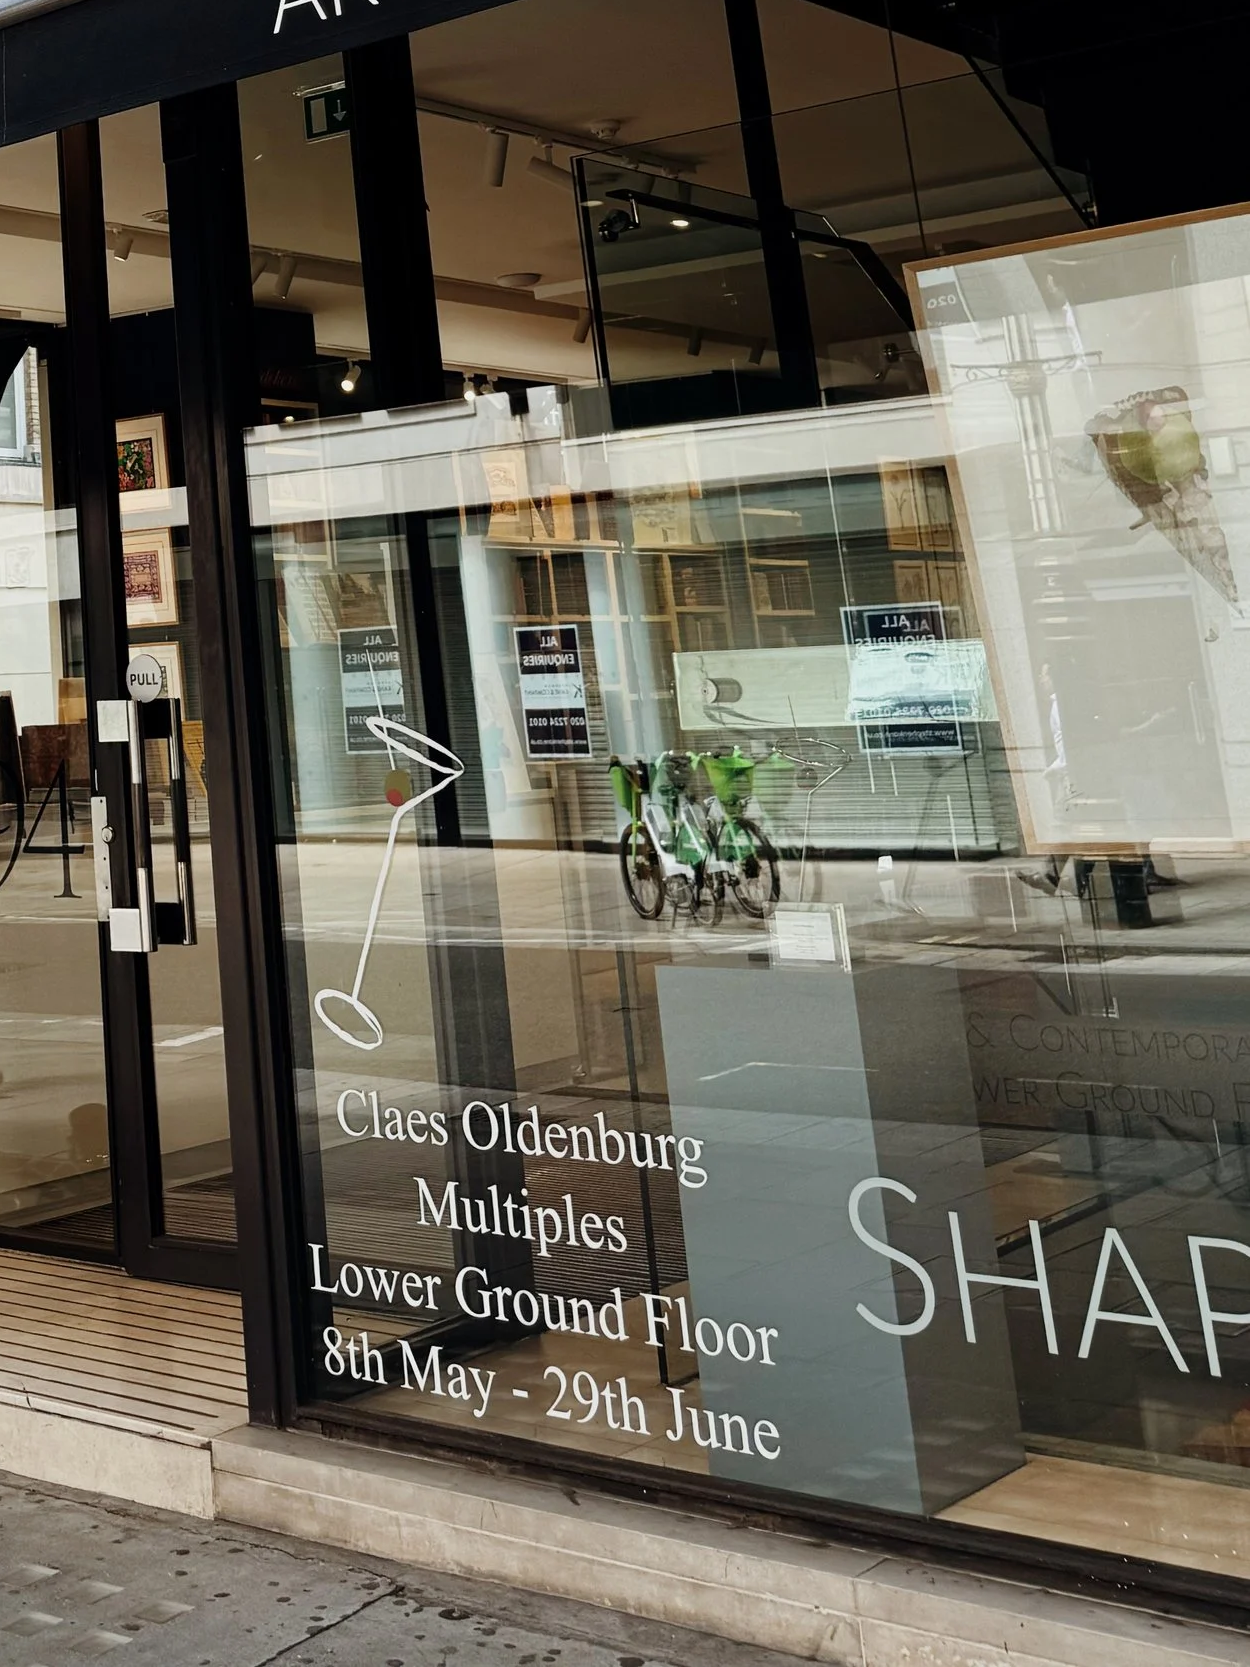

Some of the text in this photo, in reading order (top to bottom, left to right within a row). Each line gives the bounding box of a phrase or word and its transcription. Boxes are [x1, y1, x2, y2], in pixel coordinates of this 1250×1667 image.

[130, 673, 159, 686] PULL
[965, 1011, 996, 1050] &
[336, 1087, 709, 1188] Claes Oldenburg
[1056, 1070, 1216, 1119] GROUND
[414, 1176, 628, 1255] Multiples
[310, 1241, 781, 1366] Lower Ground Floor
[847, 1176, 1250, 1379] SHAP
[322, 1325, 386, 1386] 8th
[398, 1339, 497, 1418] May
[544, 1364, 650, 1437] 29th
[664, 1387, 782, 1460] June
